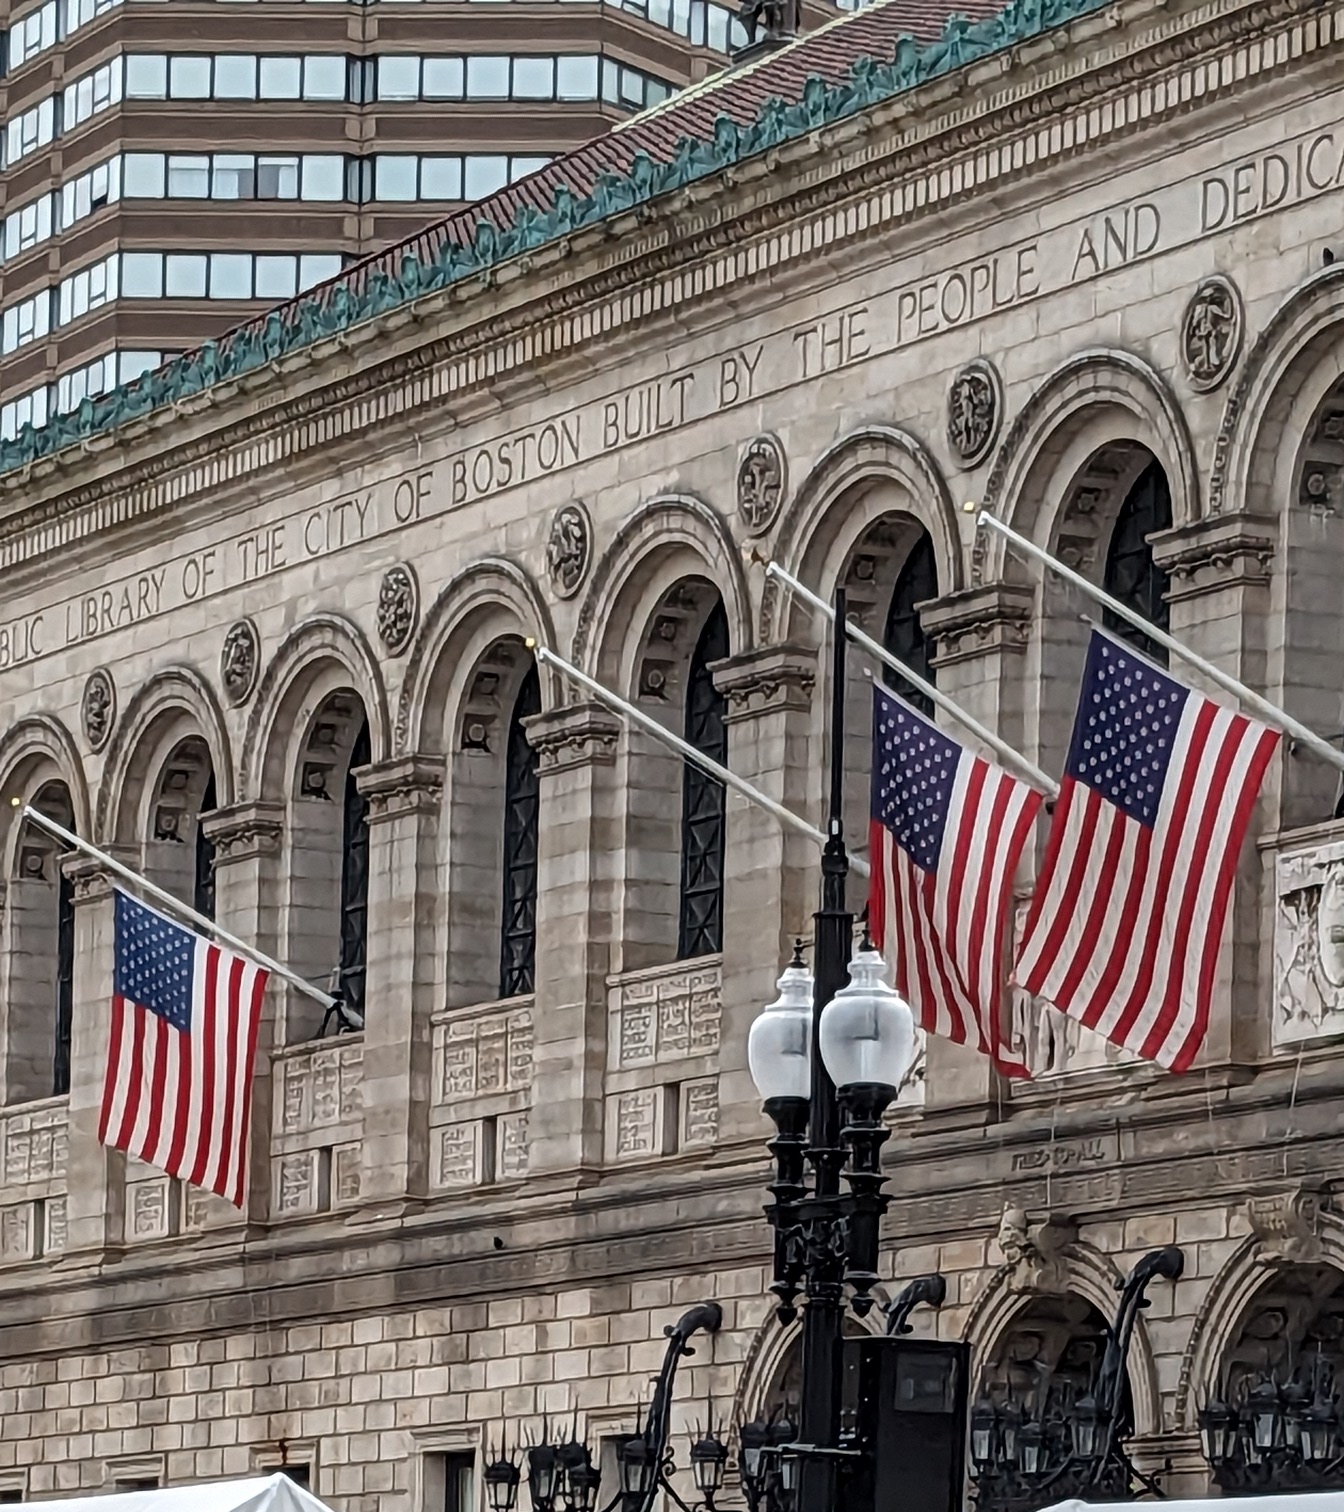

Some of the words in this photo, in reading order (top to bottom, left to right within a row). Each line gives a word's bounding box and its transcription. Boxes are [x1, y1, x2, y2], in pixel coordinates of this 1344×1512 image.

[66, 568, 166, 644] LIBRARY
[183, 550, 215, 599] OF
[237, 525, 287, 580] THE
[306, 494, 371, 555] CITY
[394, 472, 433, 522] OF
[452, 416, 581, 505] BOSTON
[603, 373, 694, 450] BUILT
[719, 345, 764, 409] BY
[793, 307, 871, 378] THE
[897, 245, 1039, 343] PEOPLE
[1072, 203, 1161, 281] AND
